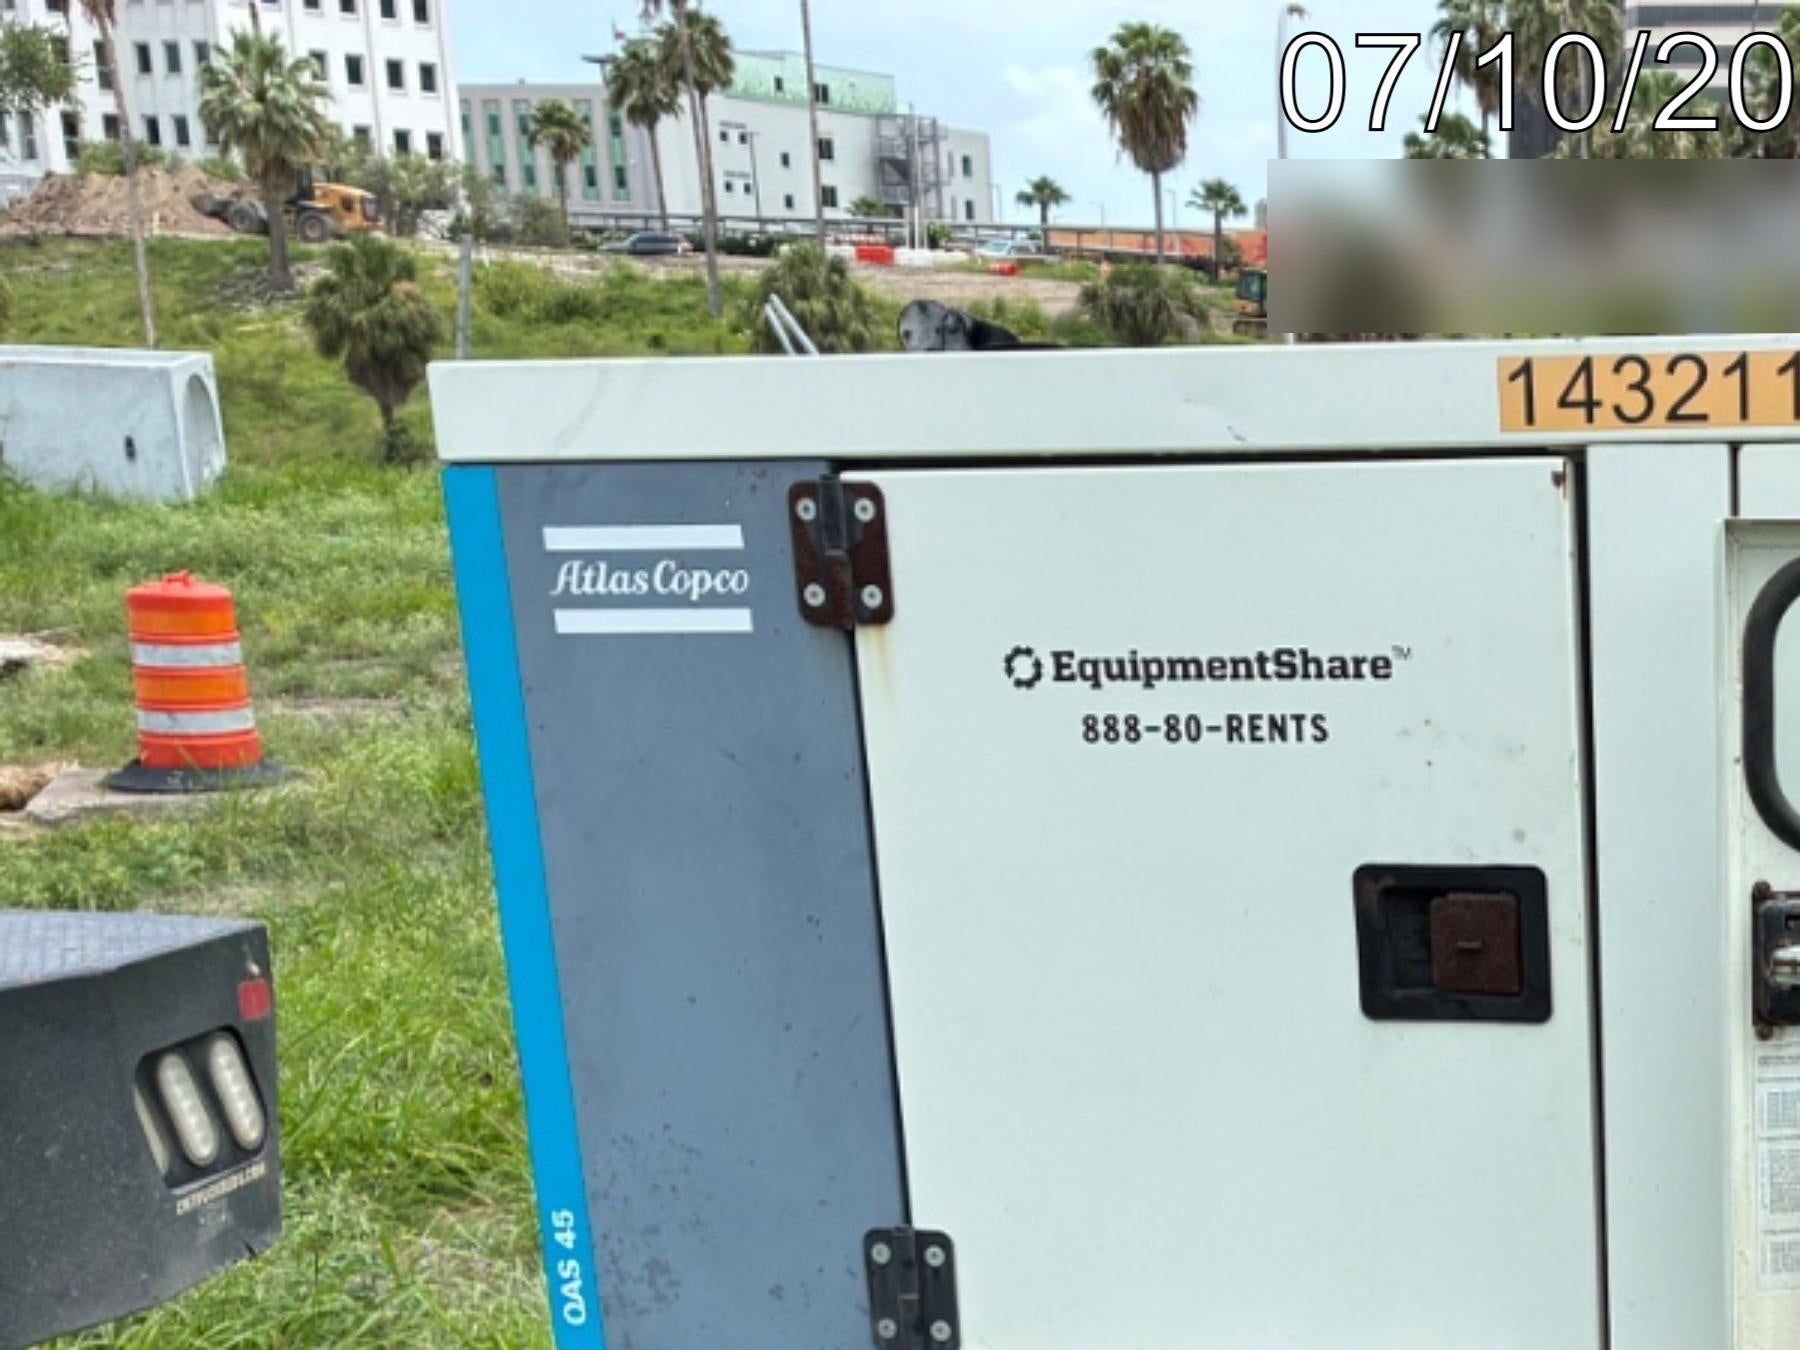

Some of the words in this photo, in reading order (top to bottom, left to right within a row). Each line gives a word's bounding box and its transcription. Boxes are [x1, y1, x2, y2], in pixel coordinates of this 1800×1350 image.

[550, 559, 649, 596] Atlas
[653, 558, 750, 602] Copco
[1081, 713, 1330, 744] 888-80-RENTS
[551, 1207, 577, 1250] 45
[557, 1259, 587, 1327] QAS
